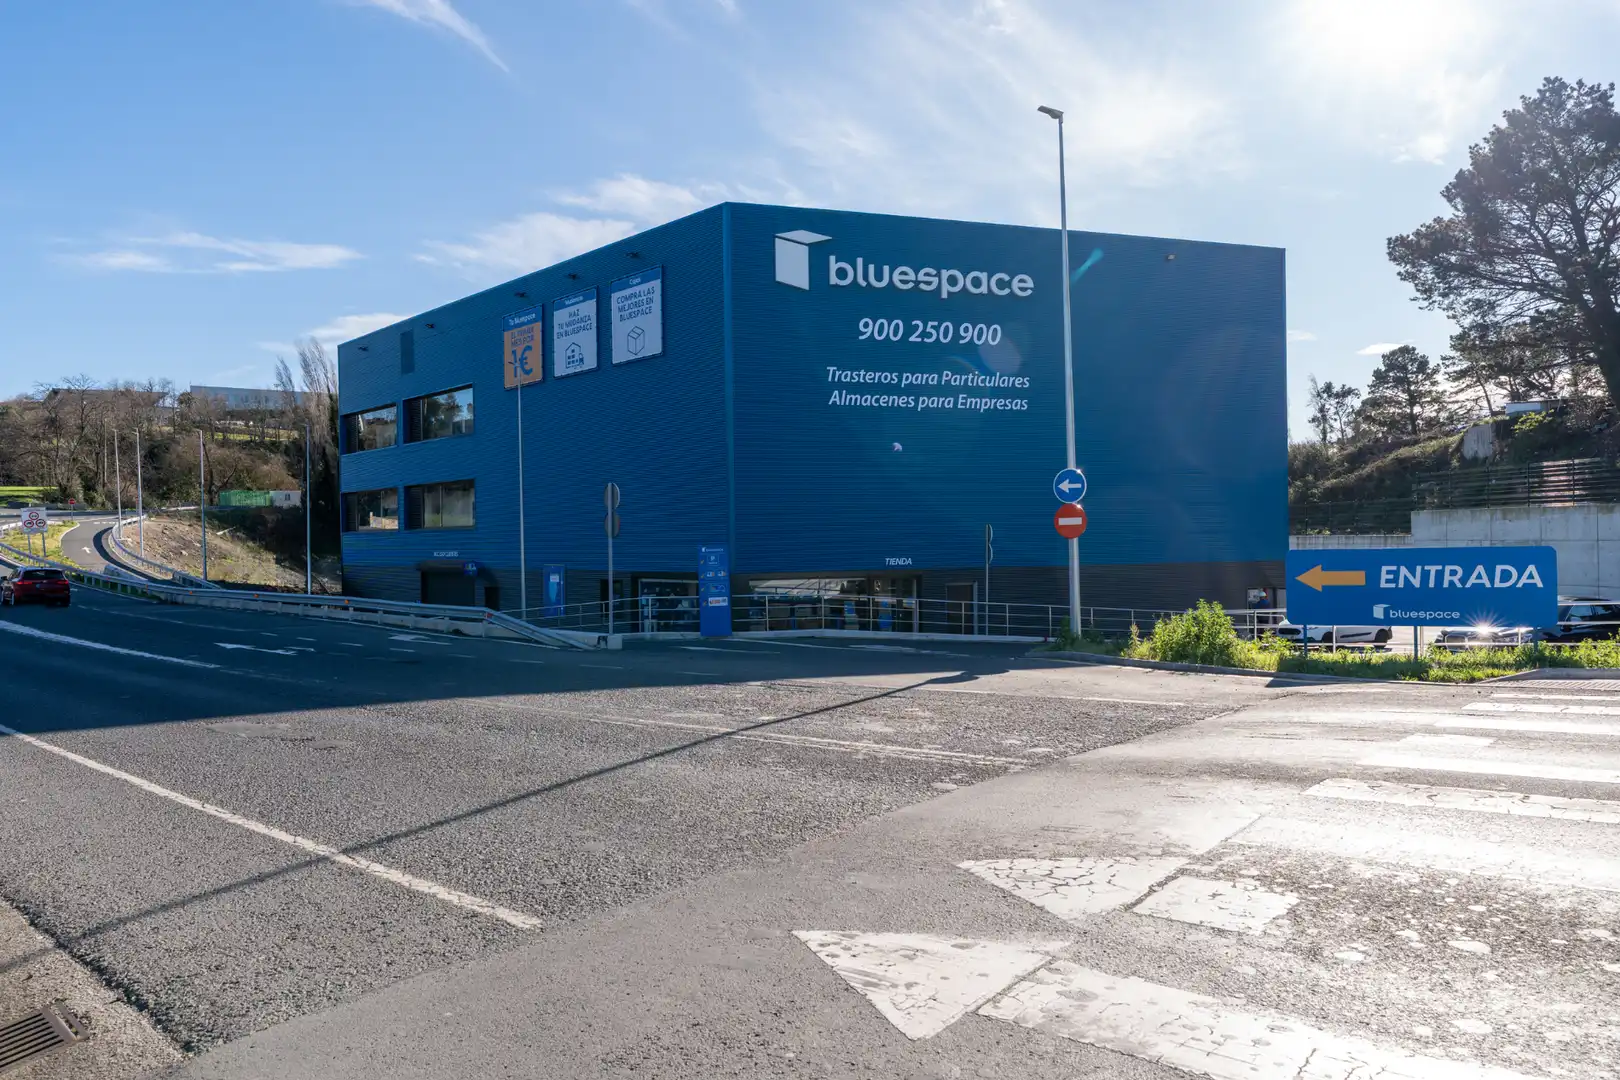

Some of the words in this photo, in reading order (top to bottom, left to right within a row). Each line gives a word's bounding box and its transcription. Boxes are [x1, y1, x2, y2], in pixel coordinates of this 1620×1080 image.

[829, 255, 1034, 299] bluespace
[616, 290, 642, 305] COMPRA
[643, 286, 655, 298] LAS
[618, 299, 644, 314] MEJORES
[645, 295, 654, 307] EN
[557, 322, 564, 331] TU
[564, 314, 592, 329] MUDANZA
[568, 309, 580, 319] HAZ
[619, 306, 652, 322] BLUESPACE
[556, 330, 564, 340] EN
[564, 323, 593, 338] BLUESPACE
[858, 317, 903, 341] 900
[909, 320, 953, 343] 250
[958, 322, 1001, 346] 900
[826, 366, 898, 384] Trasteros
[901, 372, 938, 387] para
[941, 370, 1030, 388] Particulares
[828, 390, 915, 408] Almacenes
[917, 396, 954, 411] para
[957, 394, 1028, 412] Empresas
[885, 557, 912, 566] TIENDA
[1379, 564, 1544, 589] ENTRADA
[1389, 608, 1461, 621] bluespace
